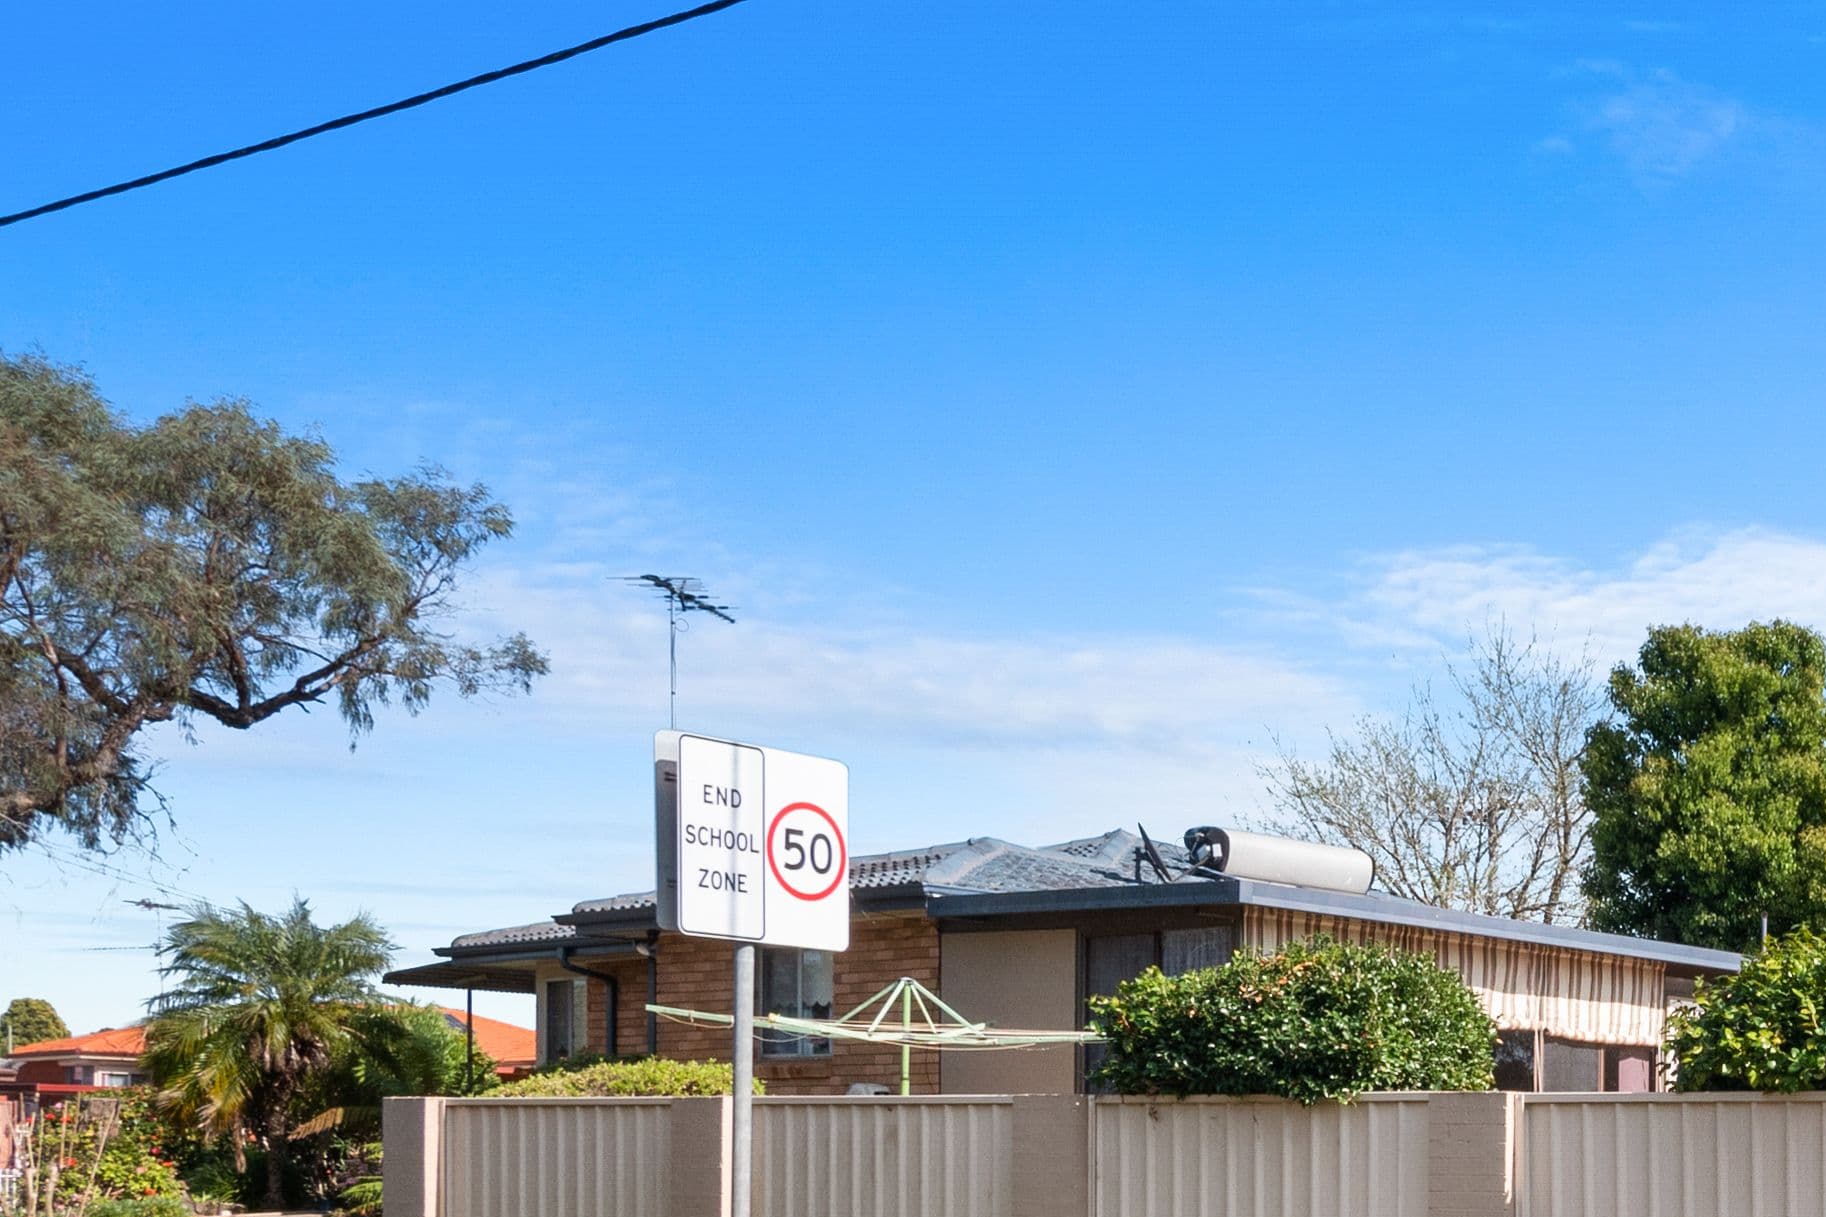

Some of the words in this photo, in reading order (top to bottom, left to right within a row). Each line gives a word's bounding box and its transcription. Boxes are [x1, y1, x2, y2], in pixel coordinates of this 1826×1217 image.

[703, 784, 742, 808] END
[685, 824, 760, 853] SCHOOL
[784, 828, 832, 875] 50
[698, 868, 748, 893] ZONE
